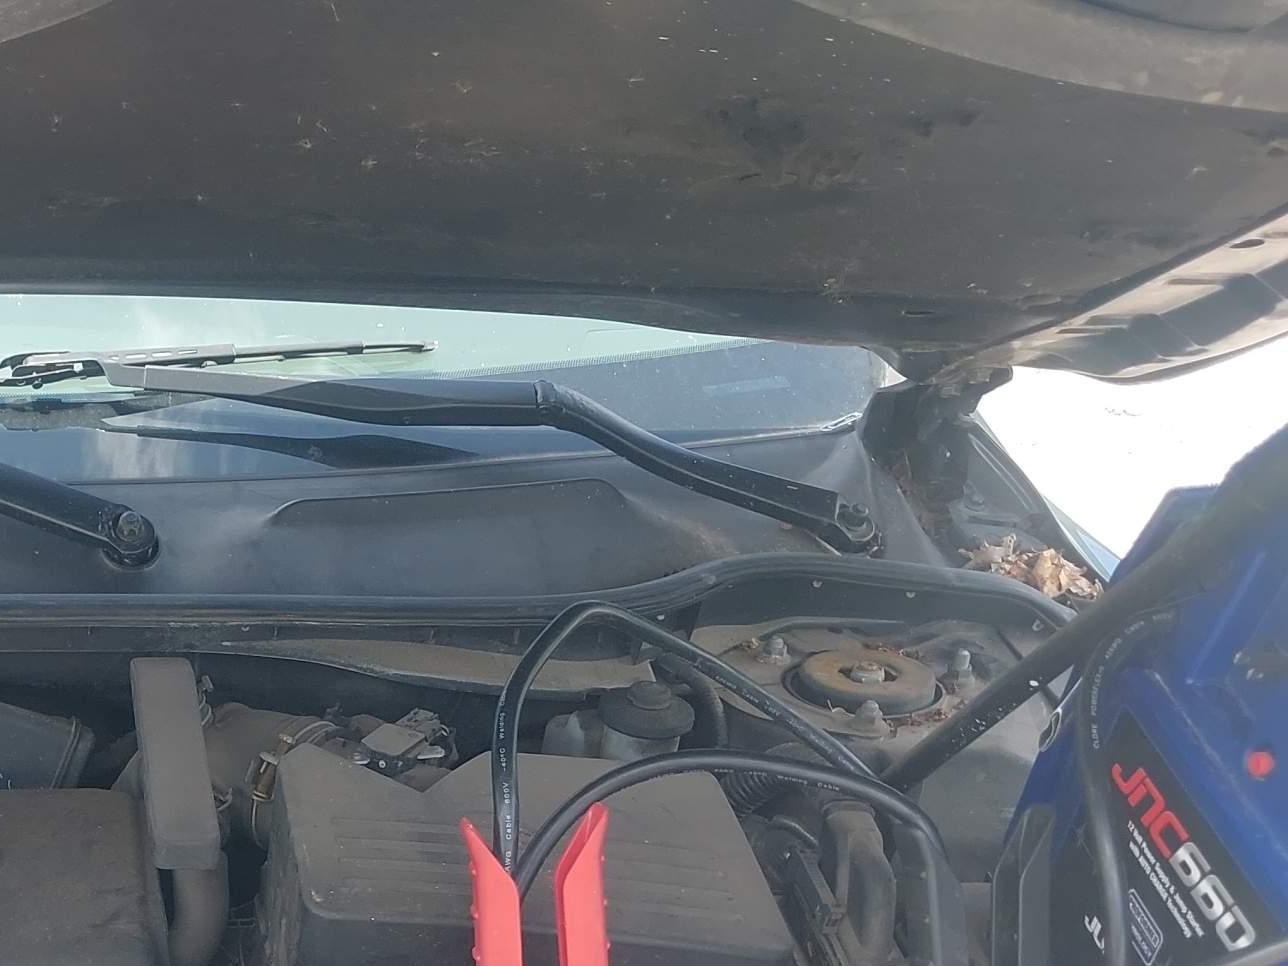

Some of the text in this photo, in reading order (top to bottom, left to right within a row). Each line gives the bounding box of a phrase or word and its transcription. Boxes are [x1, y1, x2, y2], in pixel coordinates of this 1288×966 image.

[1111, 763, 1256, 952] JNC660
[1140, 841, 1157, 864] Power
[1154, 861, 1172, 889] Supply
[1173, 892, 1189, 914] Jump
[1185, 910, 1206, 937] Starter
